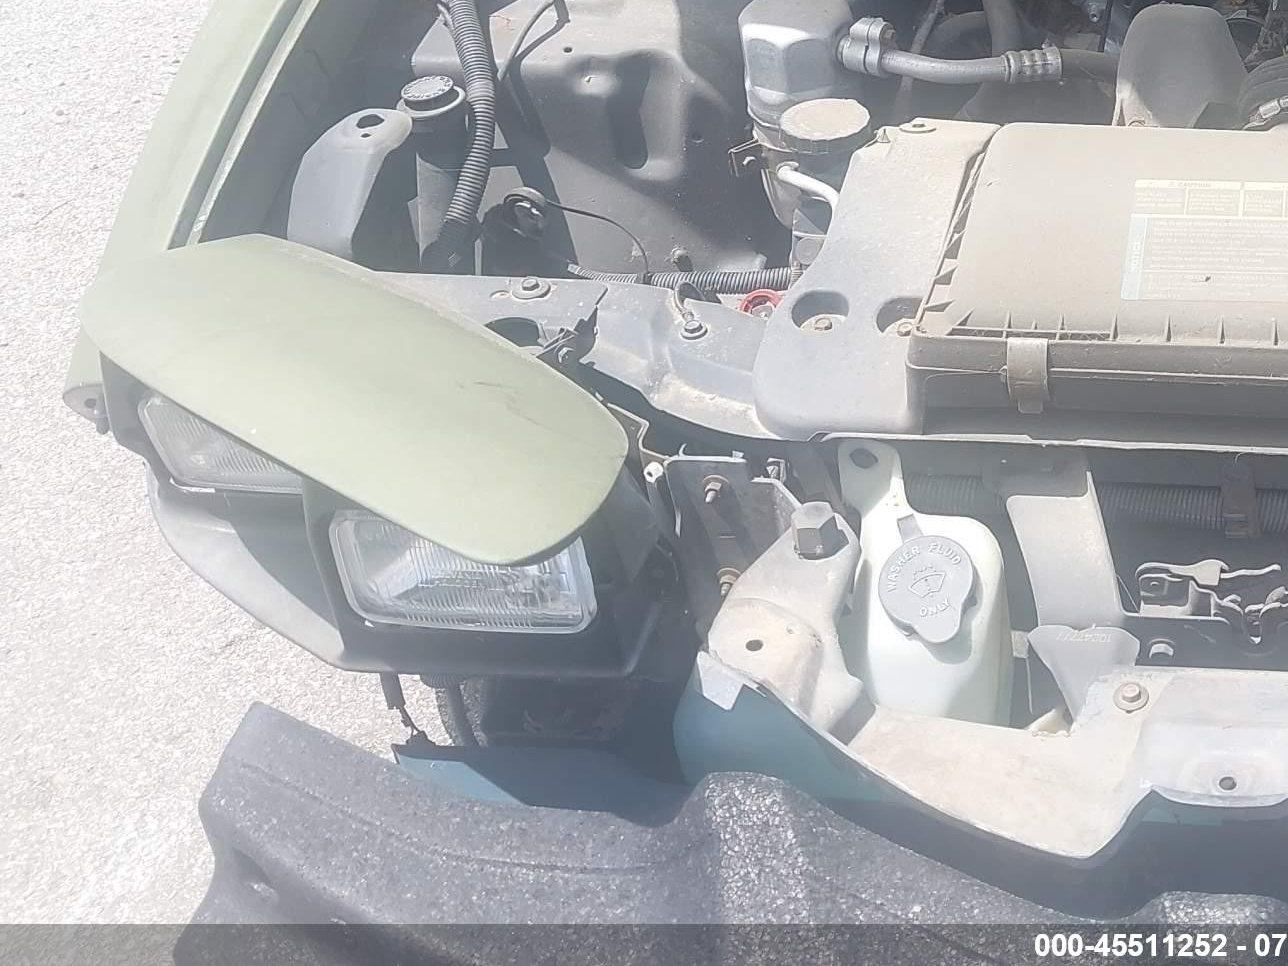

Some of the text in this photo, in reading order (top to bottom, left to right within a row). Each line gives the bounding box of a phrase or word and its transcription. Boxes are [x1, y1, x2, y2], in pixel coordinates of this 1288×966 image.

[887, 542, 962, 593] WASHER FLUID
[919, 598, 952, 618] ONLY
